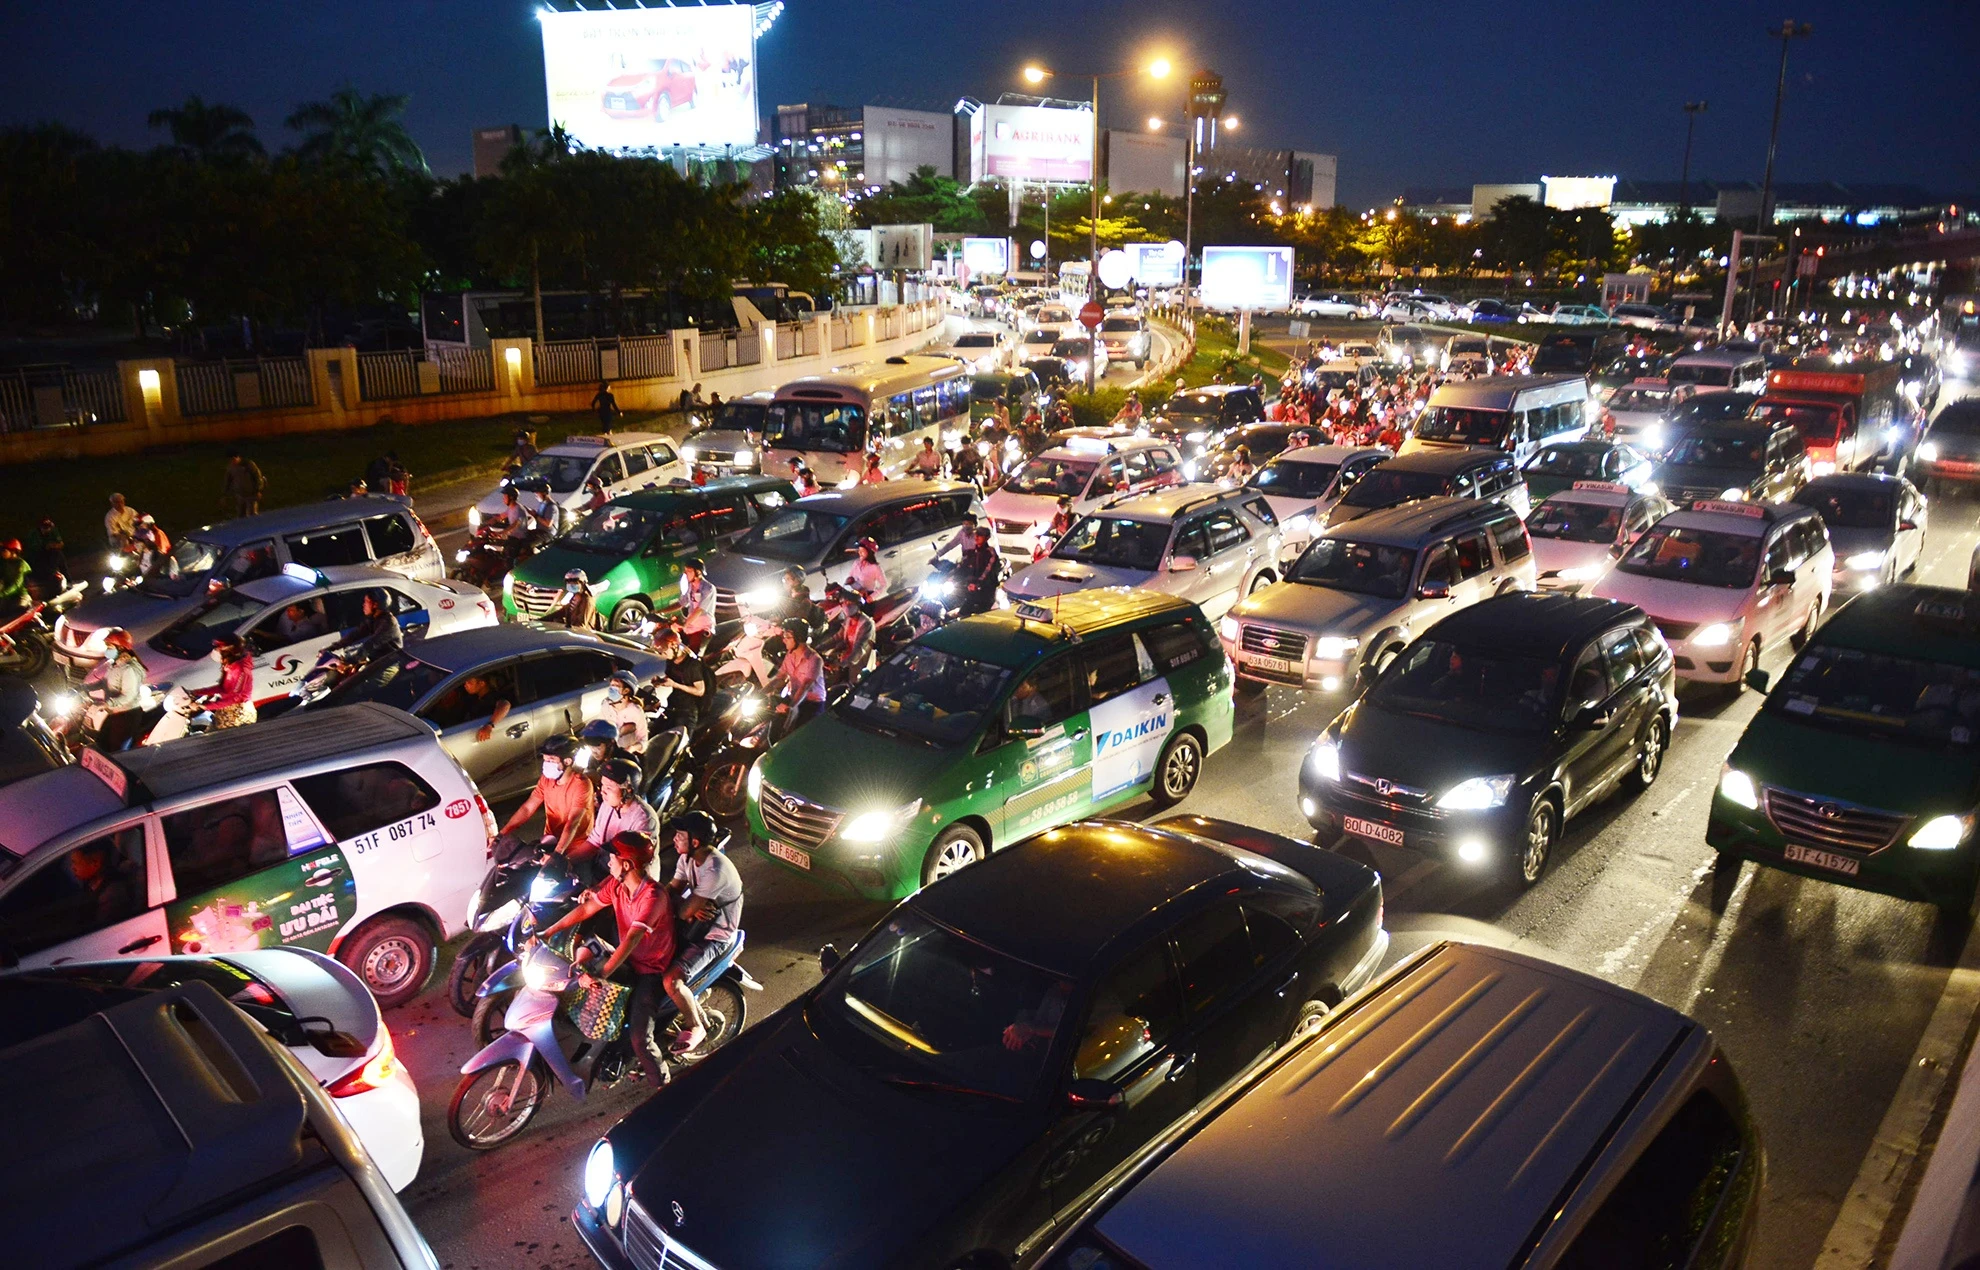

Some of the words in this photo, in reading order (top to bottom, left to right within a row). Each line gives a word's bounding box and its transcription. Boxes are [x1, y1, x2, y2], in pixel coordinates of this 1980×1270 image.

[1012, 129, 1081, 145] AGRIBANK
[1585, 483, 1615, 491] VINASUN
[1711, 503, 1746, 514] VINASUN
[1021, 603, 1044, 618] TAXI
[1112, 713, 1167, 748] DAIKIN
[446, 801, 470, 818] 7851
[355, 833, 380, 855] 51F
[389, 820, 413, 842] 087
[417, 813, 436, 831] 74
[771, 841, 783, 855] 51F
